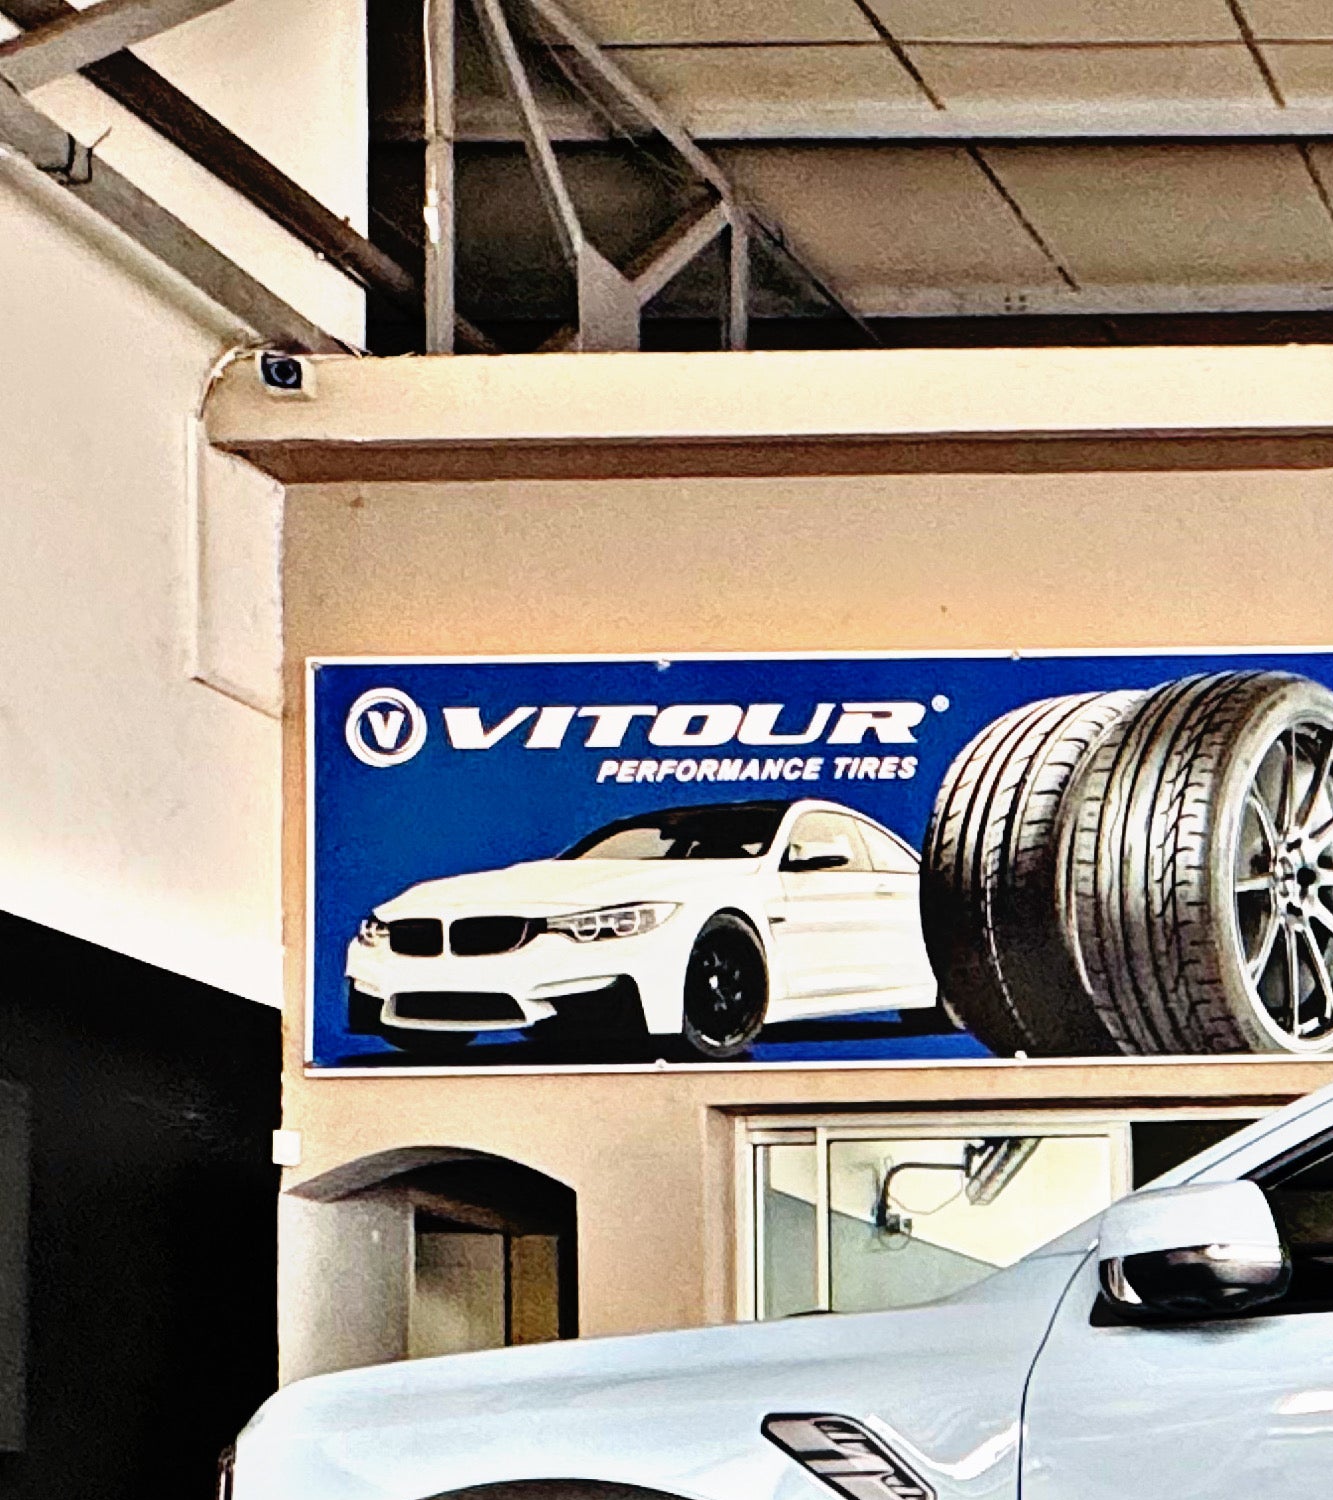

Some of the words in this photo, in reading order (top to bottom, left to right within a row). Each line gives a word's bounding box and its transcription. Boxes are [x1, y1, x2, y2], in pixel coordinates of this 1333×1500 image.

[442, 702, 928, 750] VITOUR
[596, 757, 824, 783] PERFORMANCE
[833, 755, 919, 780] TIRES
